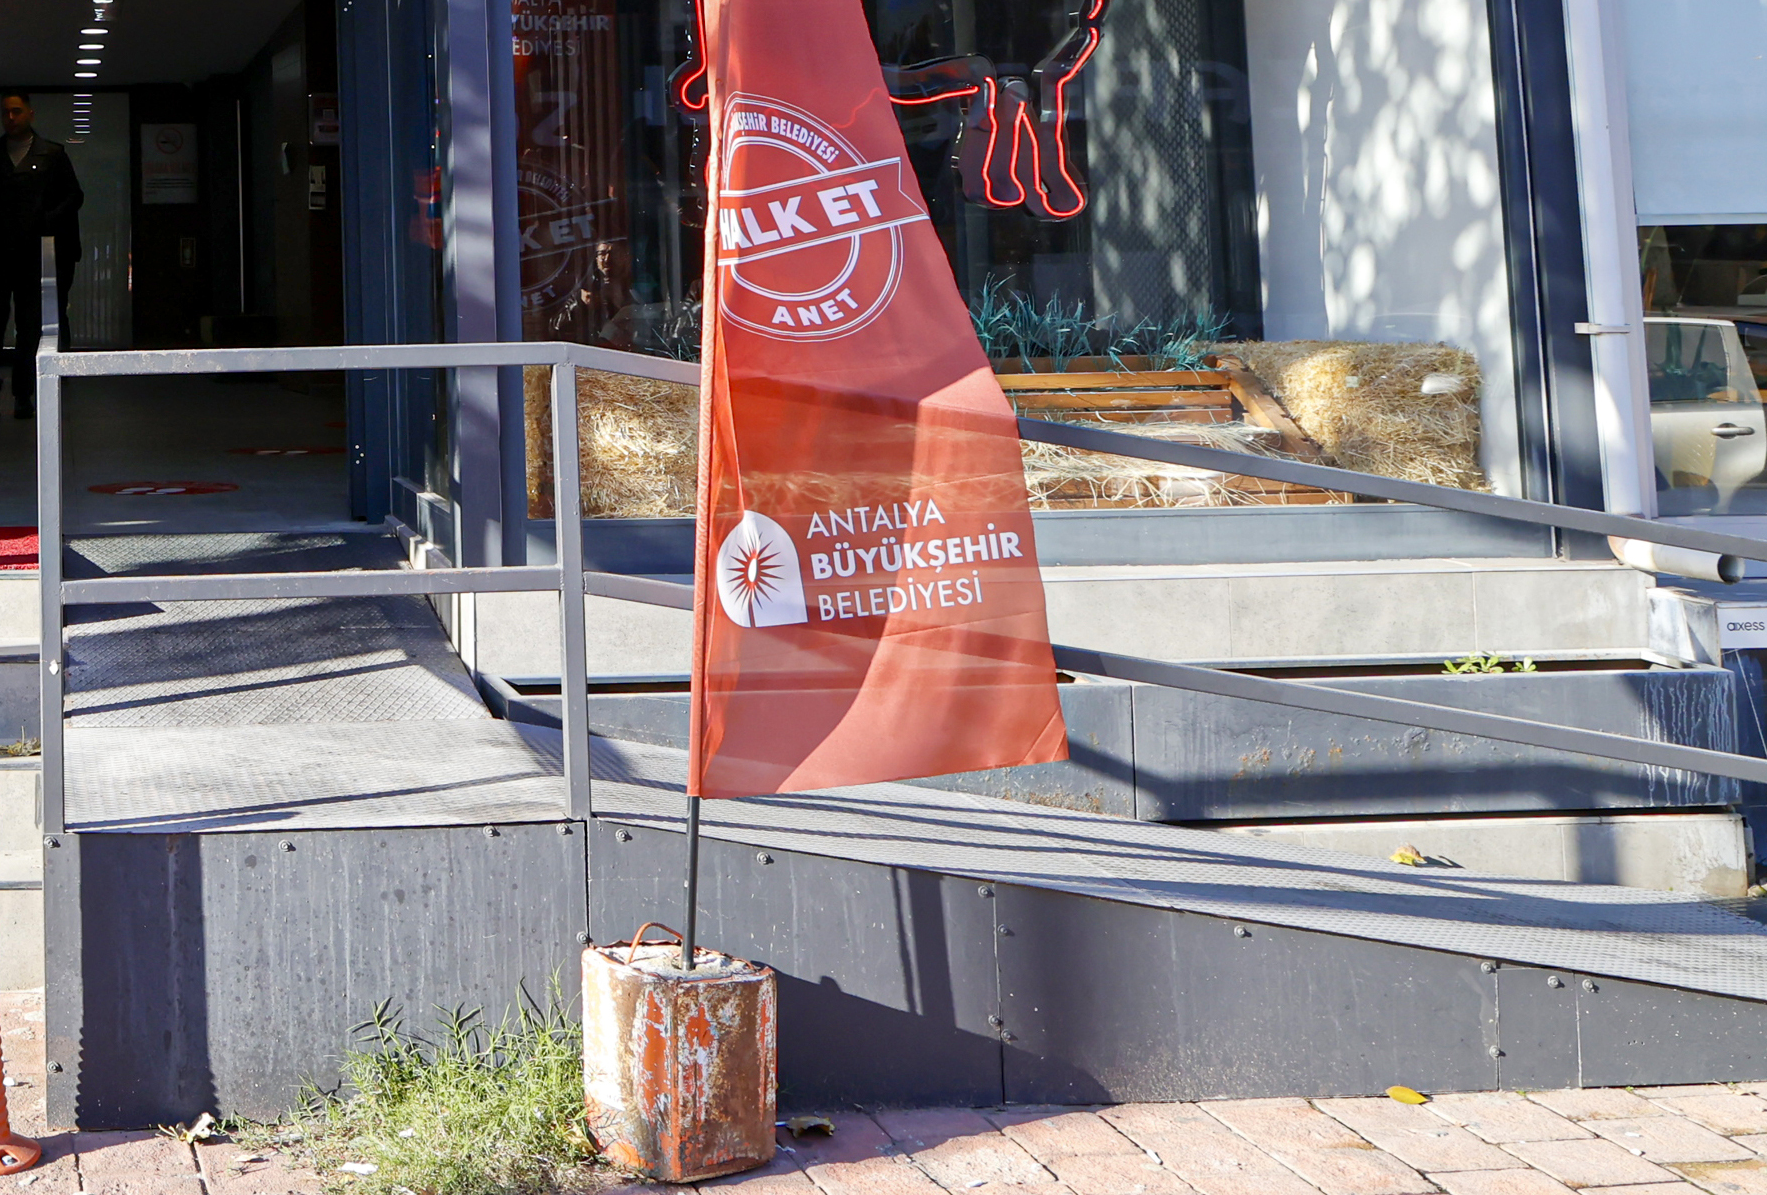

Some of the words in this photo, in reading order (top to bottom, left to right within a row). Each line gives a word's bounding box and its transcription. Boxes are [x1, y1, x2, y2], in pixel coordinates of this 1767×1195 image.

[770, 116, 841, 164] BELEDİYESİ
[719, 195, 818, 252] HALK
[816, 179, 883, 228] ET
[771, 287, 860, 327] ANET
[806, 498, 946, 540] ANTALYA
[810, 522, 1024, 581] BÜYÜKŞEHİR
[818, 569, 984, 622] BELEDİYESİ
[1726, 620, 1766, 632] axess
